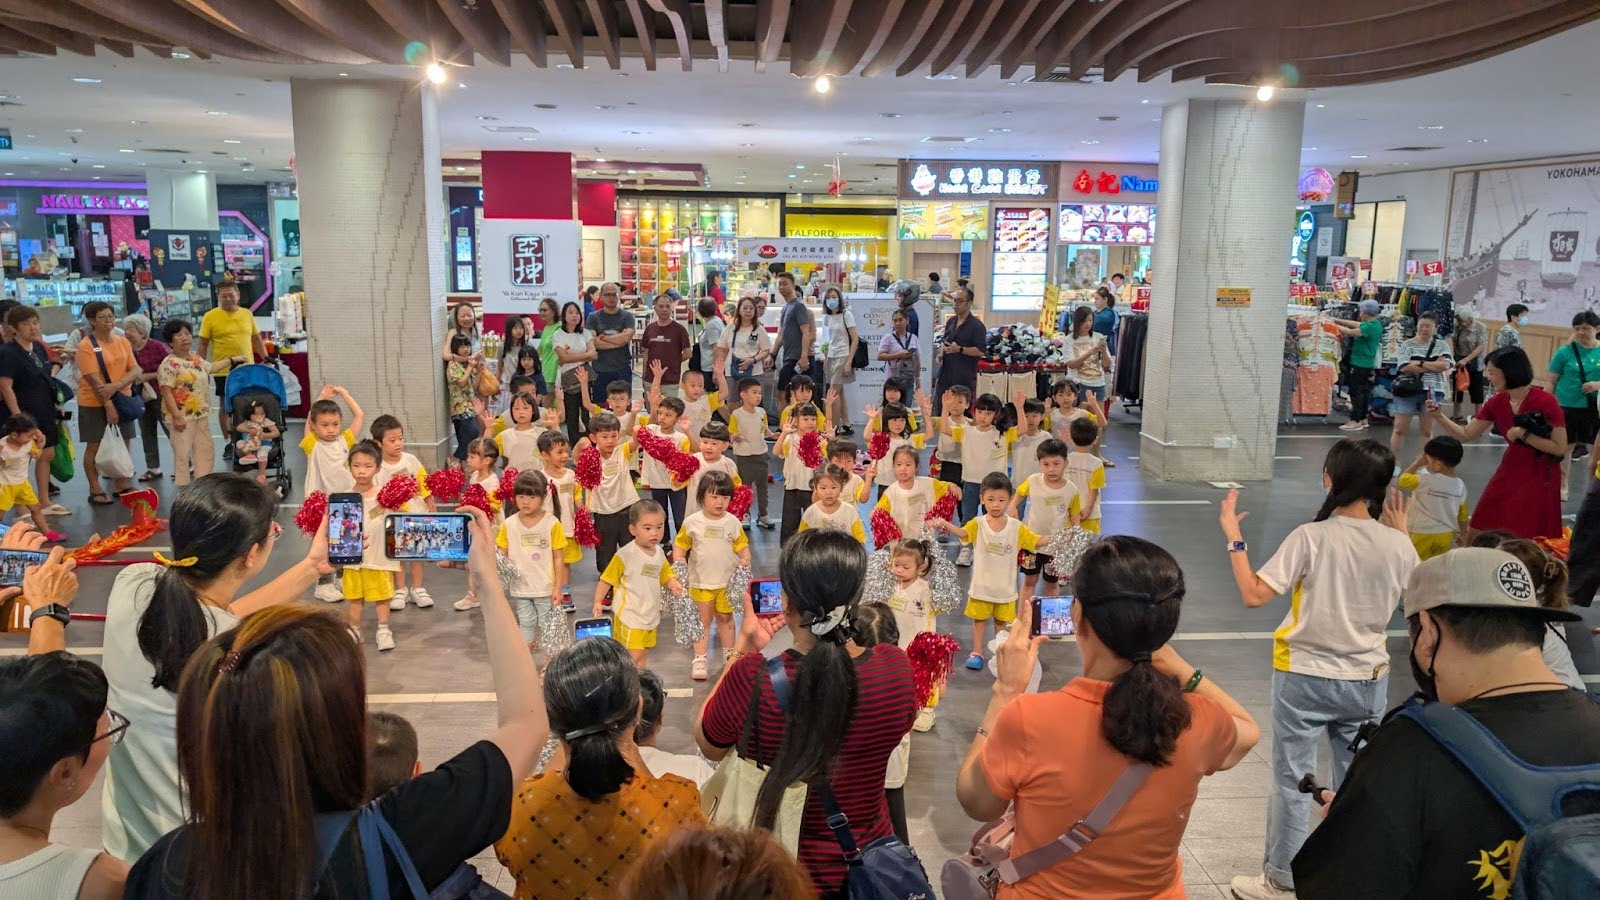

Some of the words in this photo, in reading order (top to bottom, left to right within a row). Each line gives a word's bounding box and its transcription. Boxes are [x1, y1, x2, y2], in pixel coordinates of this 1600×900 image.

[1074, 170, 1120, 194] 南記
[1121, 176, 1158, 192] Nam
[42, 194, 86, 209] NAIL
[90, 195, 148, 210] PALAC
